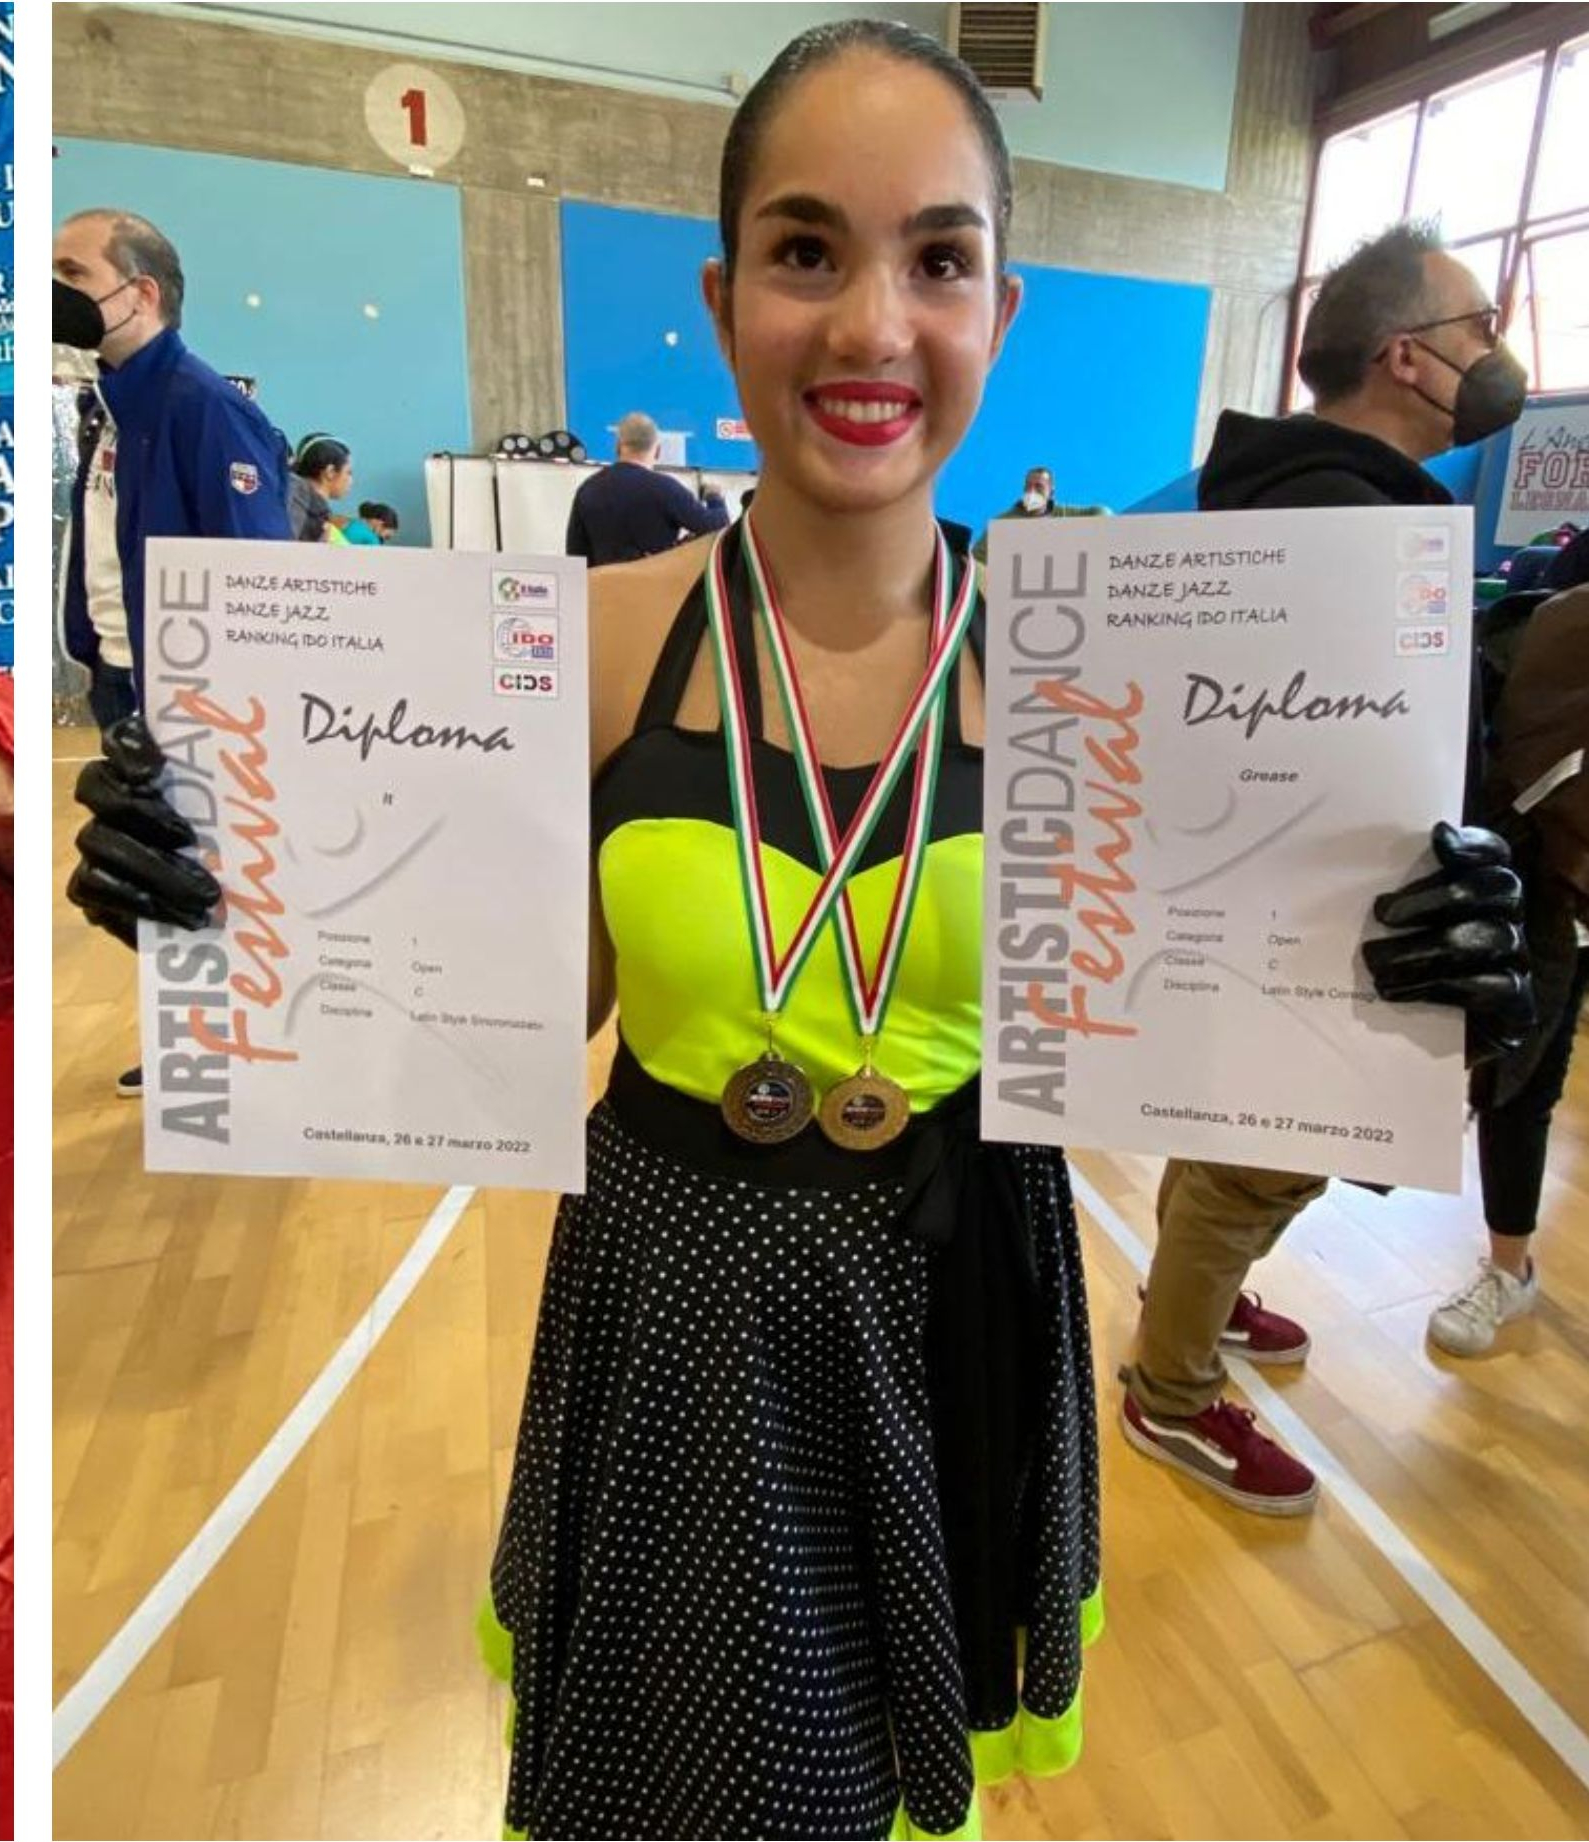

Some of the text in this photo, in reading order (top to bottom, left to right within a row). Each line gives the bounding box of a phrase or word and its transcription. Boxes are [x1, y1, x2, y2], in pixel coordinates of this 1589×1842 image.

[401, 89, 430, 147] 1
[1109, 548, 1287, 570] DANZE ARTISTICHE
[226, 575, 378, 597] DANZE ARTISTICHE
[1107, 580, 1232, 602] DANZE JAZZ
[226, 602, 330, 624] DANZE JAZZ
[1107, 608, 1289, 629] RANKING IDO ITALIA
[226, 629, 385, 653] RANKING IDO ITALIA
[513, 632, 554, 647] IDO
[1183, 670, 1411, 741] Diploma
[300, 692, 517, 762] Diploma
[1239, 768, 1299, 783] Grease
[1267, 934, 1302, 947] Open
[412, 961, 442, 976] Open
[1268, 959, 1279, 970] C
[1262, 985, 1291, 996] Latin
[1295, 986, 1325, 998] Style
[1140, 1102, 1235, 1127] Castellanza,
[1238, 1113, 1257, 1127] 26
[1274, 1117, 1294, 1131] 27
[1297, 1122, 1349, 1137] marzo
[1352, 1126, 1395, 1143] 2022
[303, 1127, 392, 1147] Castellanza,
[394, 1133, 412, 1147] 26
[428, 1136, 445, 1149] 27
[448, 1140, 494, 1151] marzo
[496, 1140, 532, 1154] 2022
